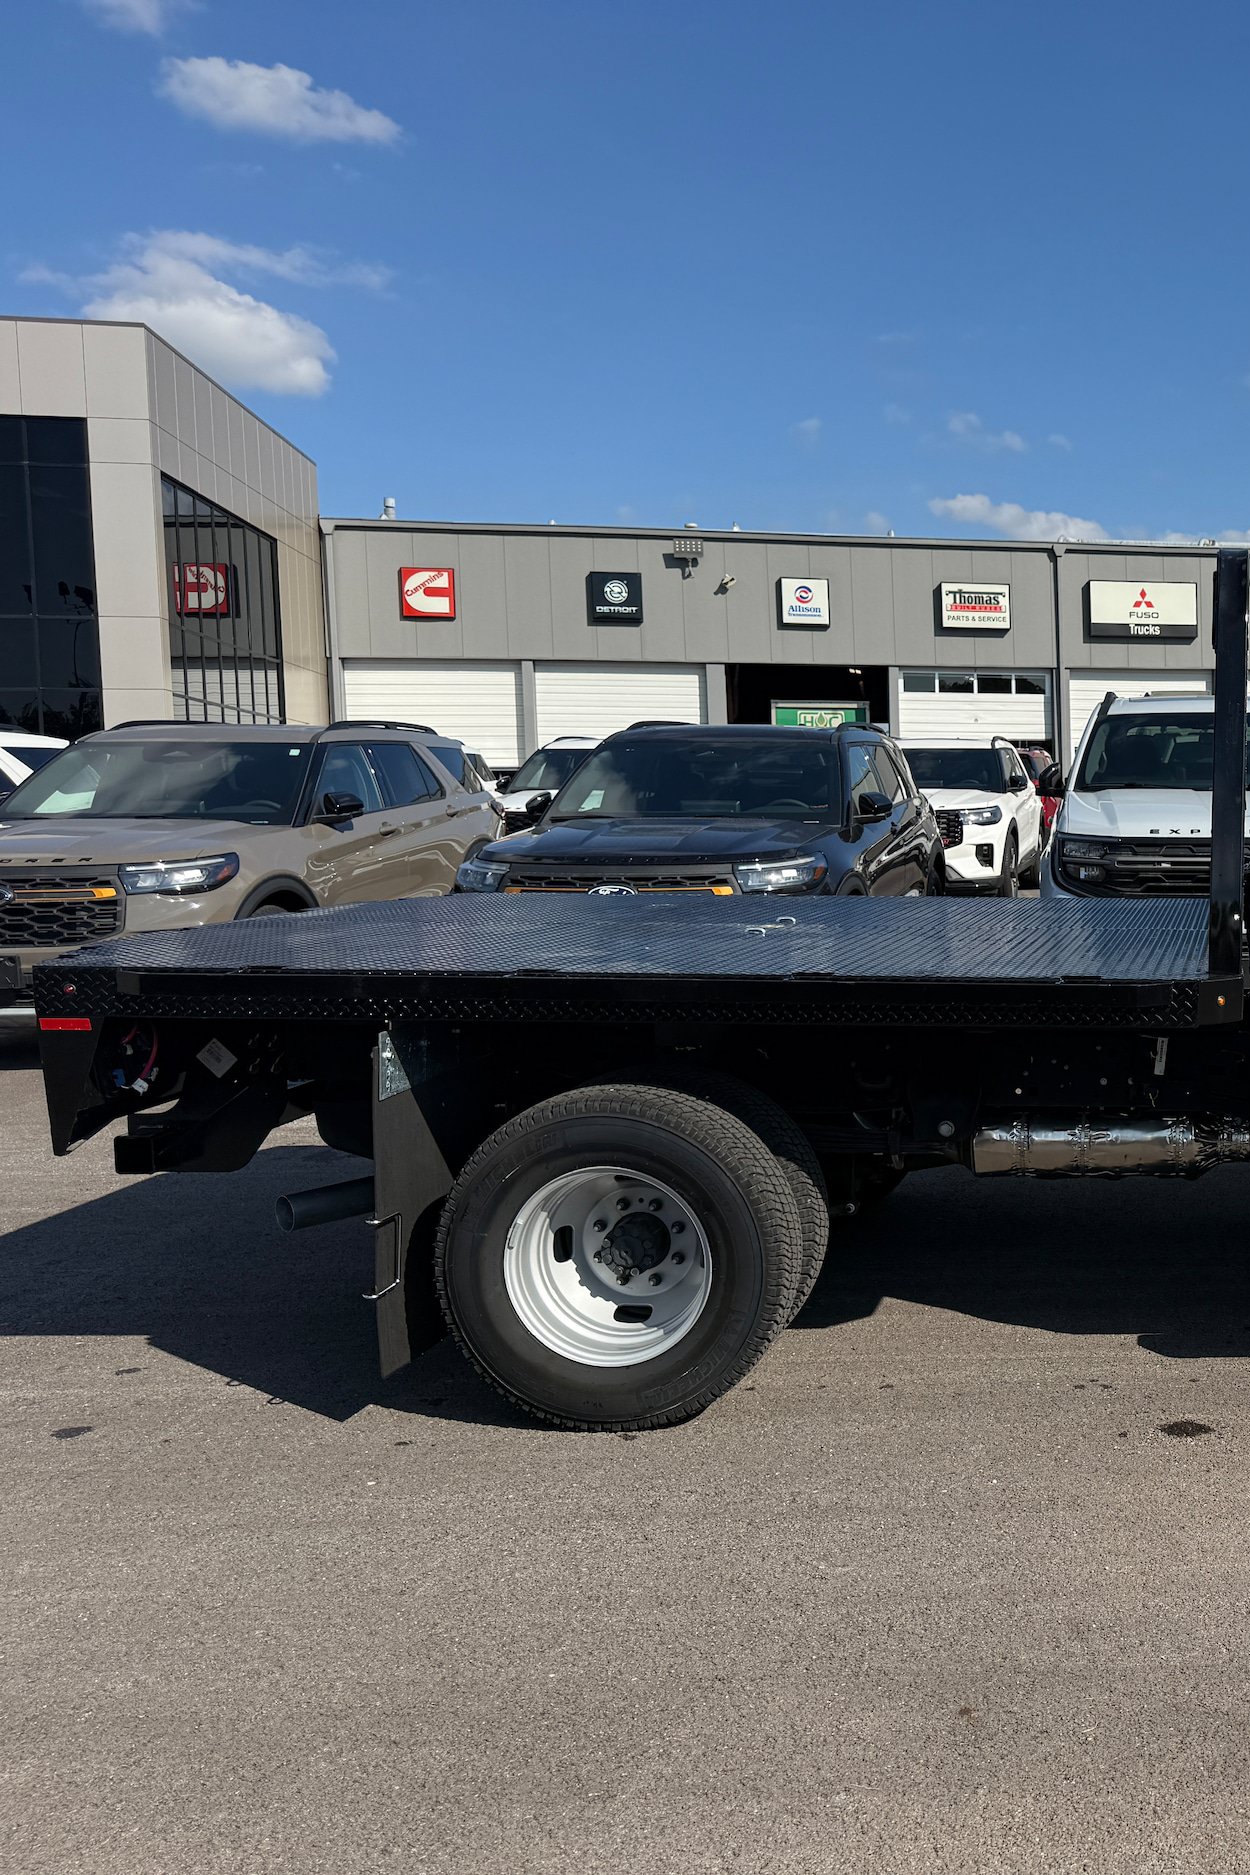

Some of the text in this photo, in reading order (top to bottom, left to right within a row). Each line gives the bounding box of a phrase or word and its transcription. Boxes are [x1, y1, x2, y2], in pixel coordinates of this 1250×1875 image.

[405, 572, 444, 597] Cummins
[951, 588, 1001, 606] Thomas
[595, 605, 639, 614] DETROIT
[788, 604, 821, 614] Allison
[1129, 611, 1160, 619] FUSO
[1129, 624, 1161, 635] Trucks
